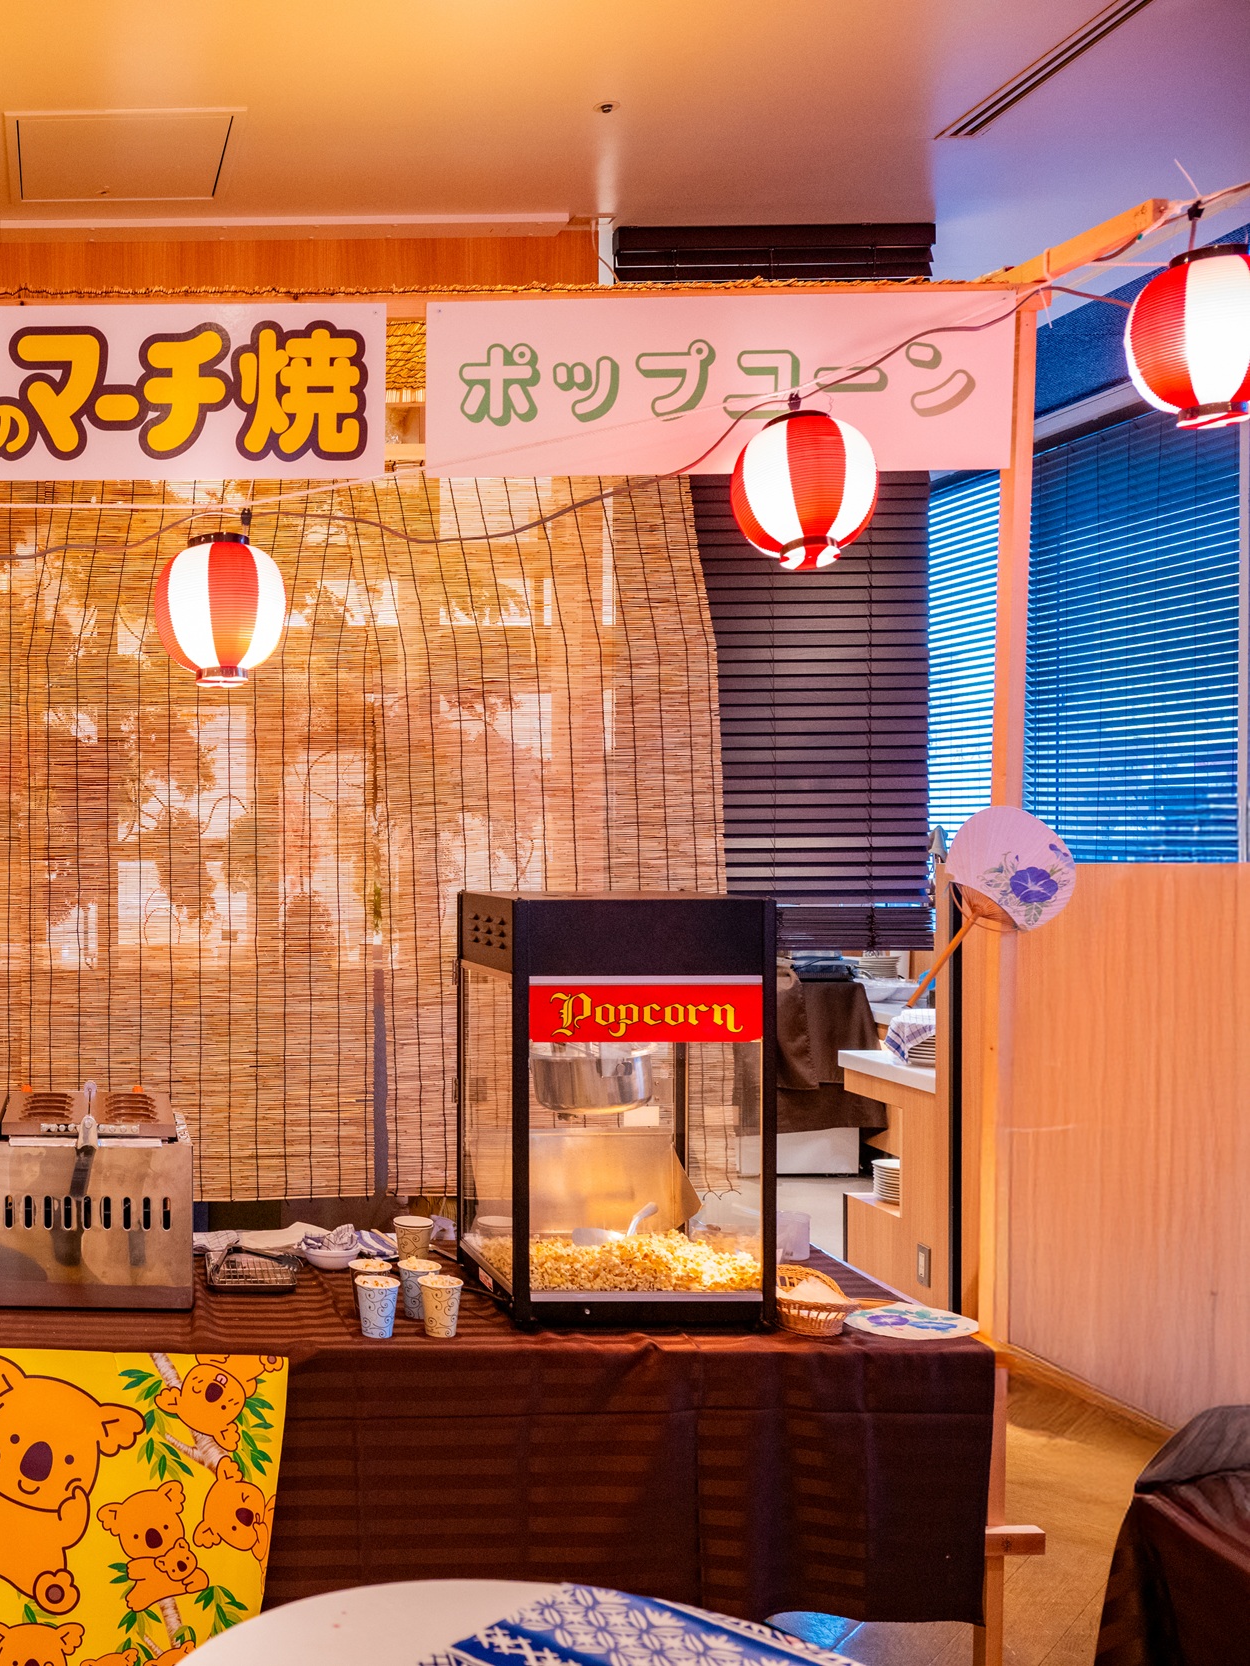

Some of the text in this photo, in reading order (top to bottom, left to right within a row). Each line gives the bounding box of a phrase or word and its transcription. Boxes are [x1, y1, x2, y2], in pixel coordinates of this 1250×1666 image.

[459, 338, 976, 427] ポップコーン
[550, 991, 744, 1038] Popcorn
